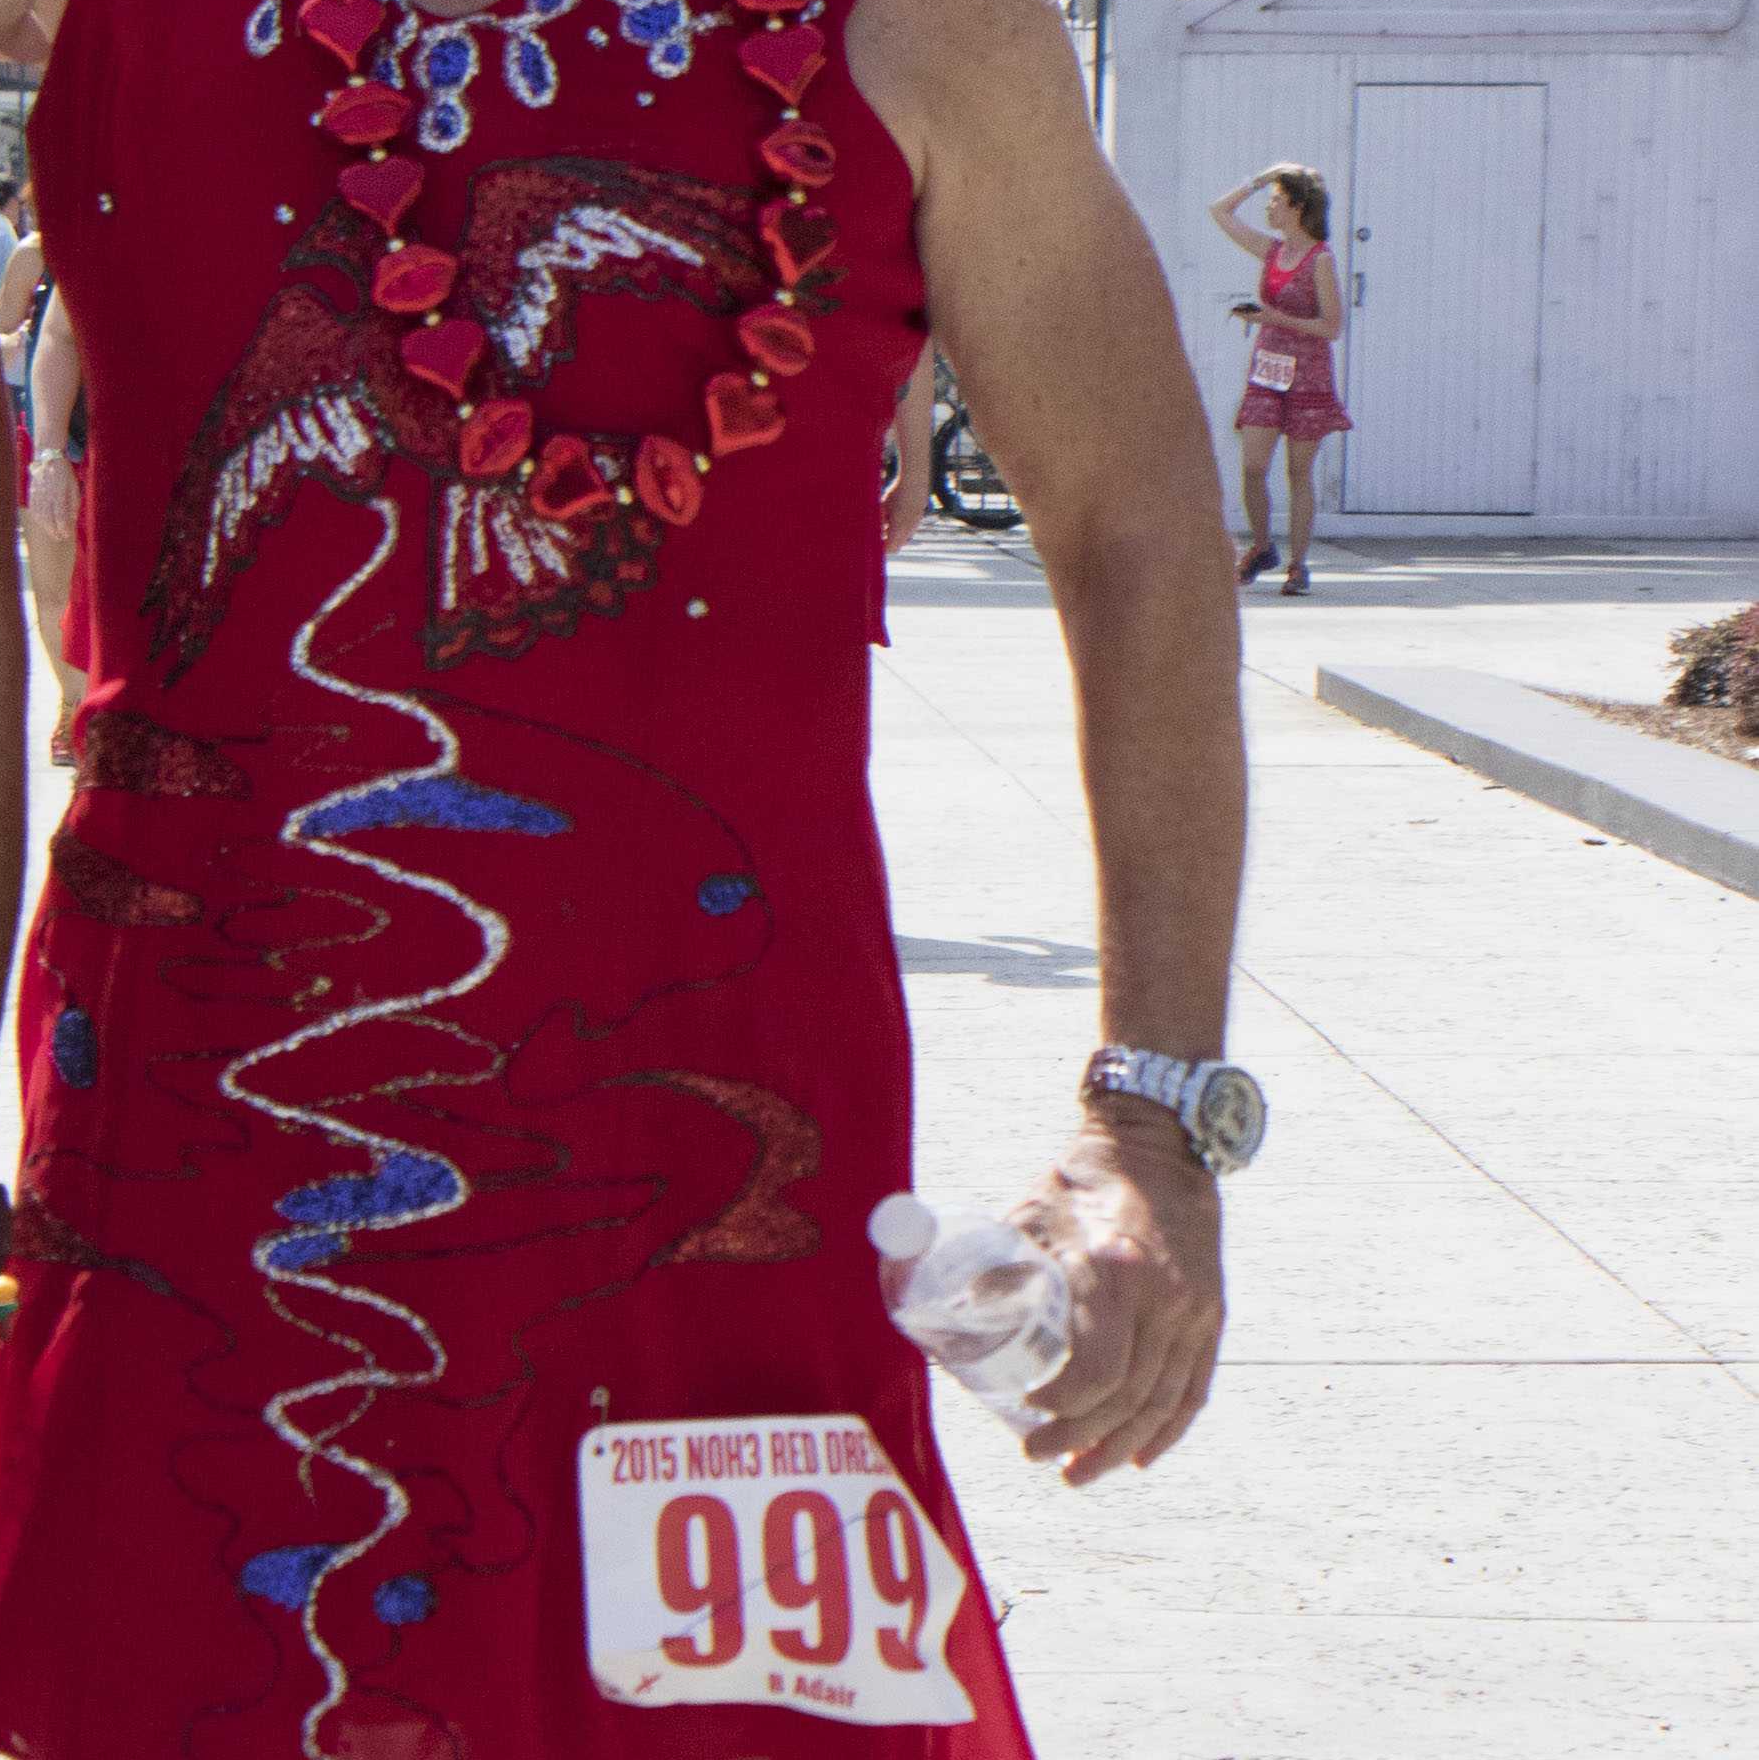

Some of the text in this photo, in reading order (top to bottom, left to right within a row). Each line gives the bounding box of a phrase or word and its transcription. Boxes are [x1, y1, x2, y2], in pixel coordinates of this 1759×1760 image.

[612, 1436, 678, 1484] 2015
[686, 1431, 762, 1480] NOH3
[771, 1429, 820, 1475] RED
[656, 1488, 929, 1673] 999
